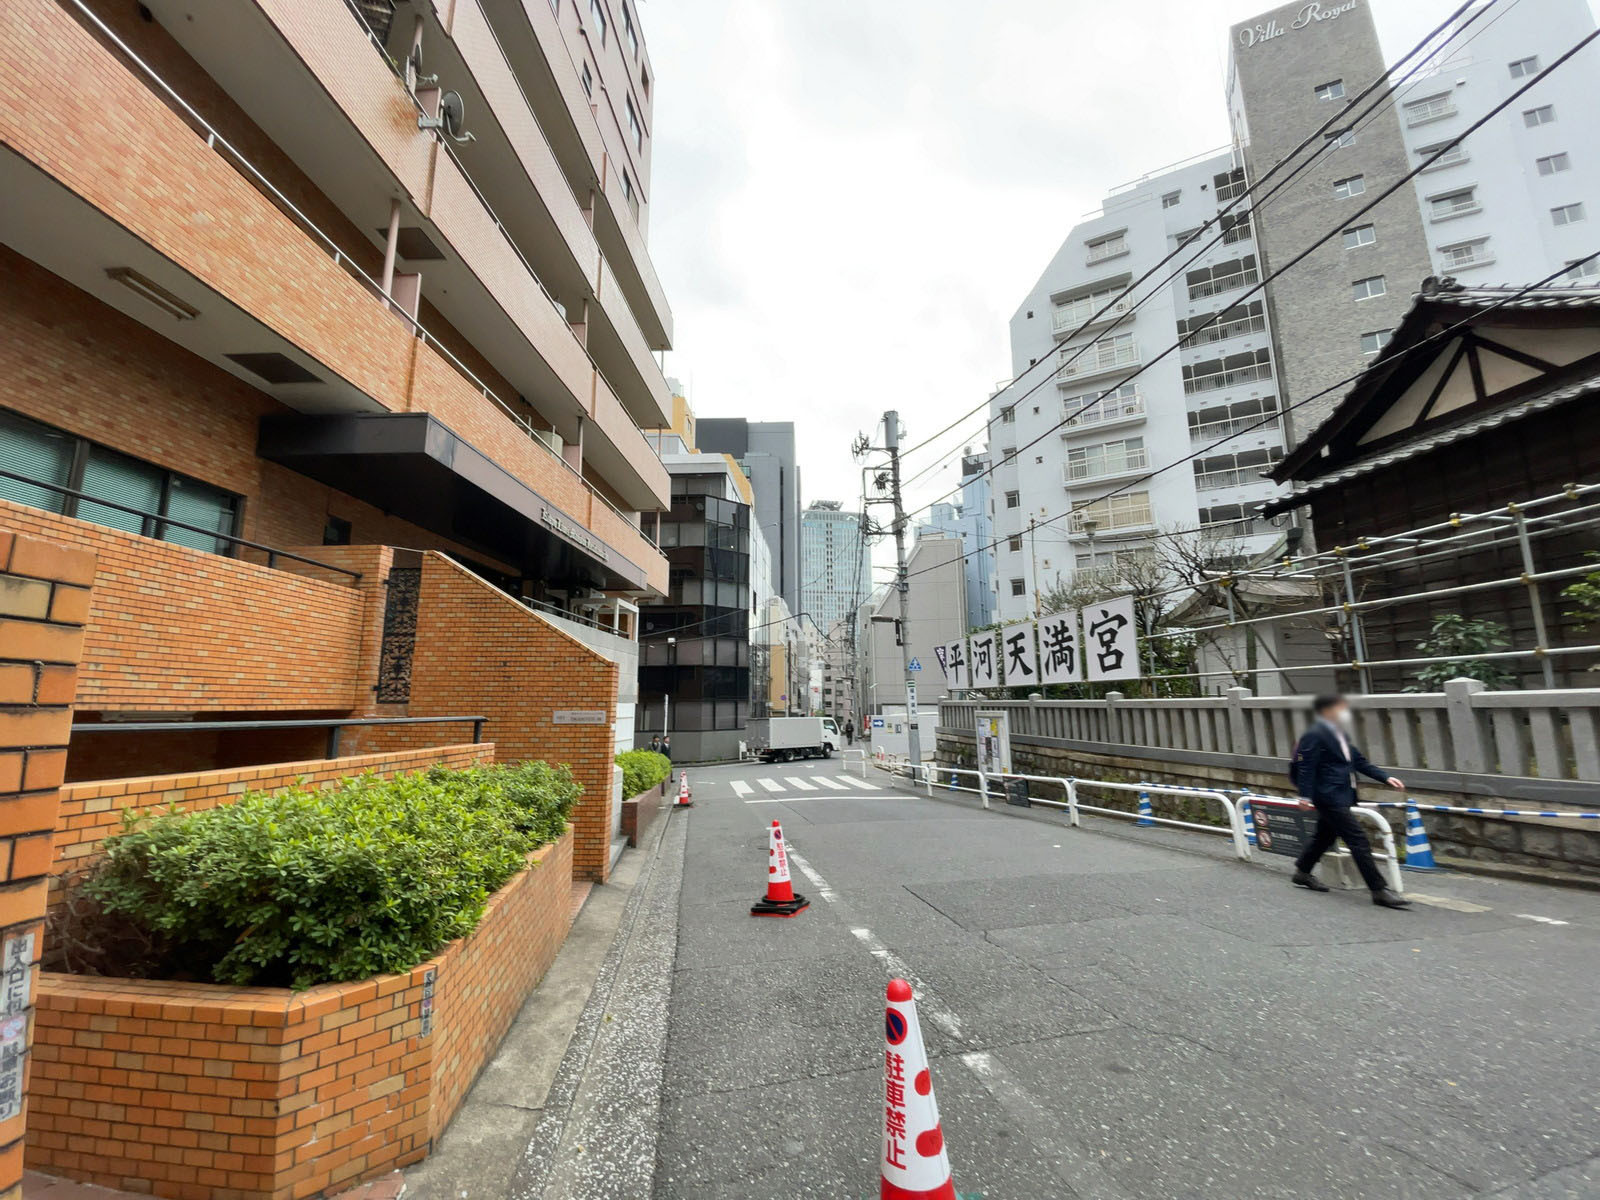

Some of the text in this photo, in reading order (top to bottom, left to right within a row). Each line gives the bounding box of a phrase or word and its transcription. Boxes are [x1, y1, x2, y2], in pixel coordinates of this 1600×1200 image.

[1240, 0, 1357, 48] Villa Royal
[948, 609, 1128, 684] 平河天満宮
[886, 1050, 907, 1171] 駐車禁止
